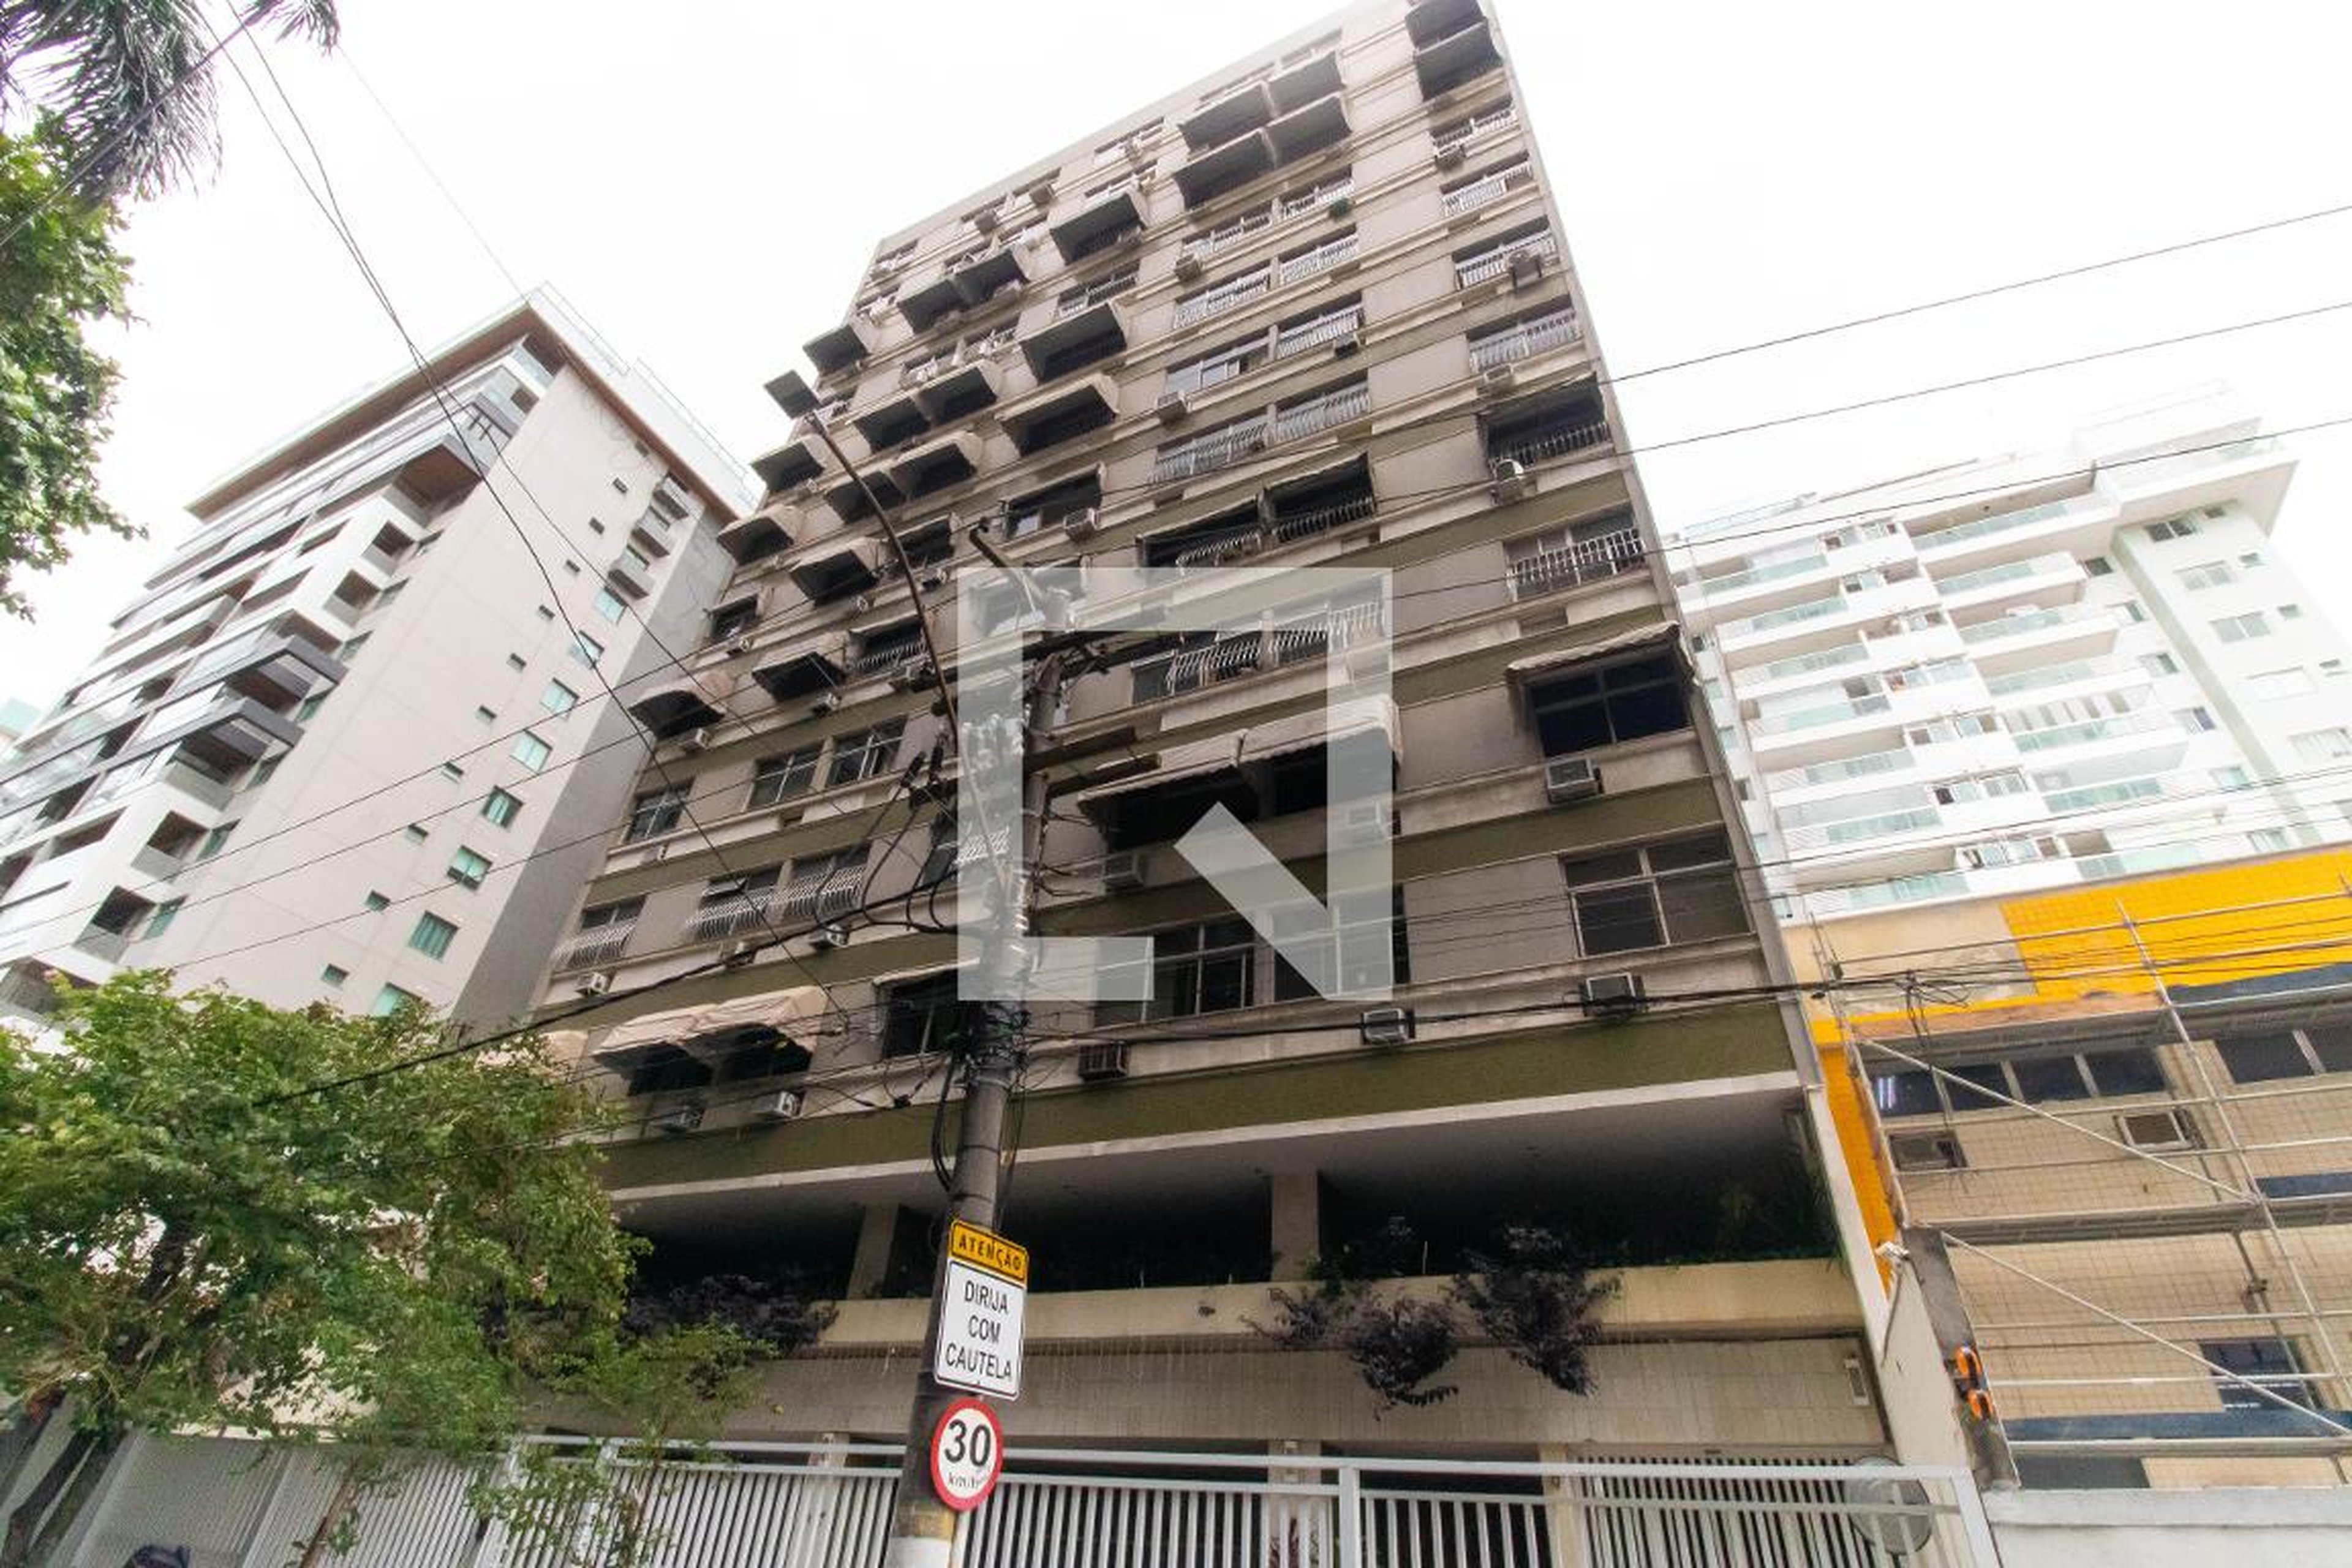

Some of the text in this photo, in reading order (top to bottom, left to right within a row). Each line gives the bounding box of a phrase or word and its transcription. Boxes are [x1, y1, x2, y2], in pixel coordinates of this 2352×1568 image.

[965, 1280, 1009, 1315] DIRIJA
[968, 1314, 1001, 1344] COM
[945, 1342, 1012, 1381] CAUTELA
[944, 1419, 992, 1467] 30
